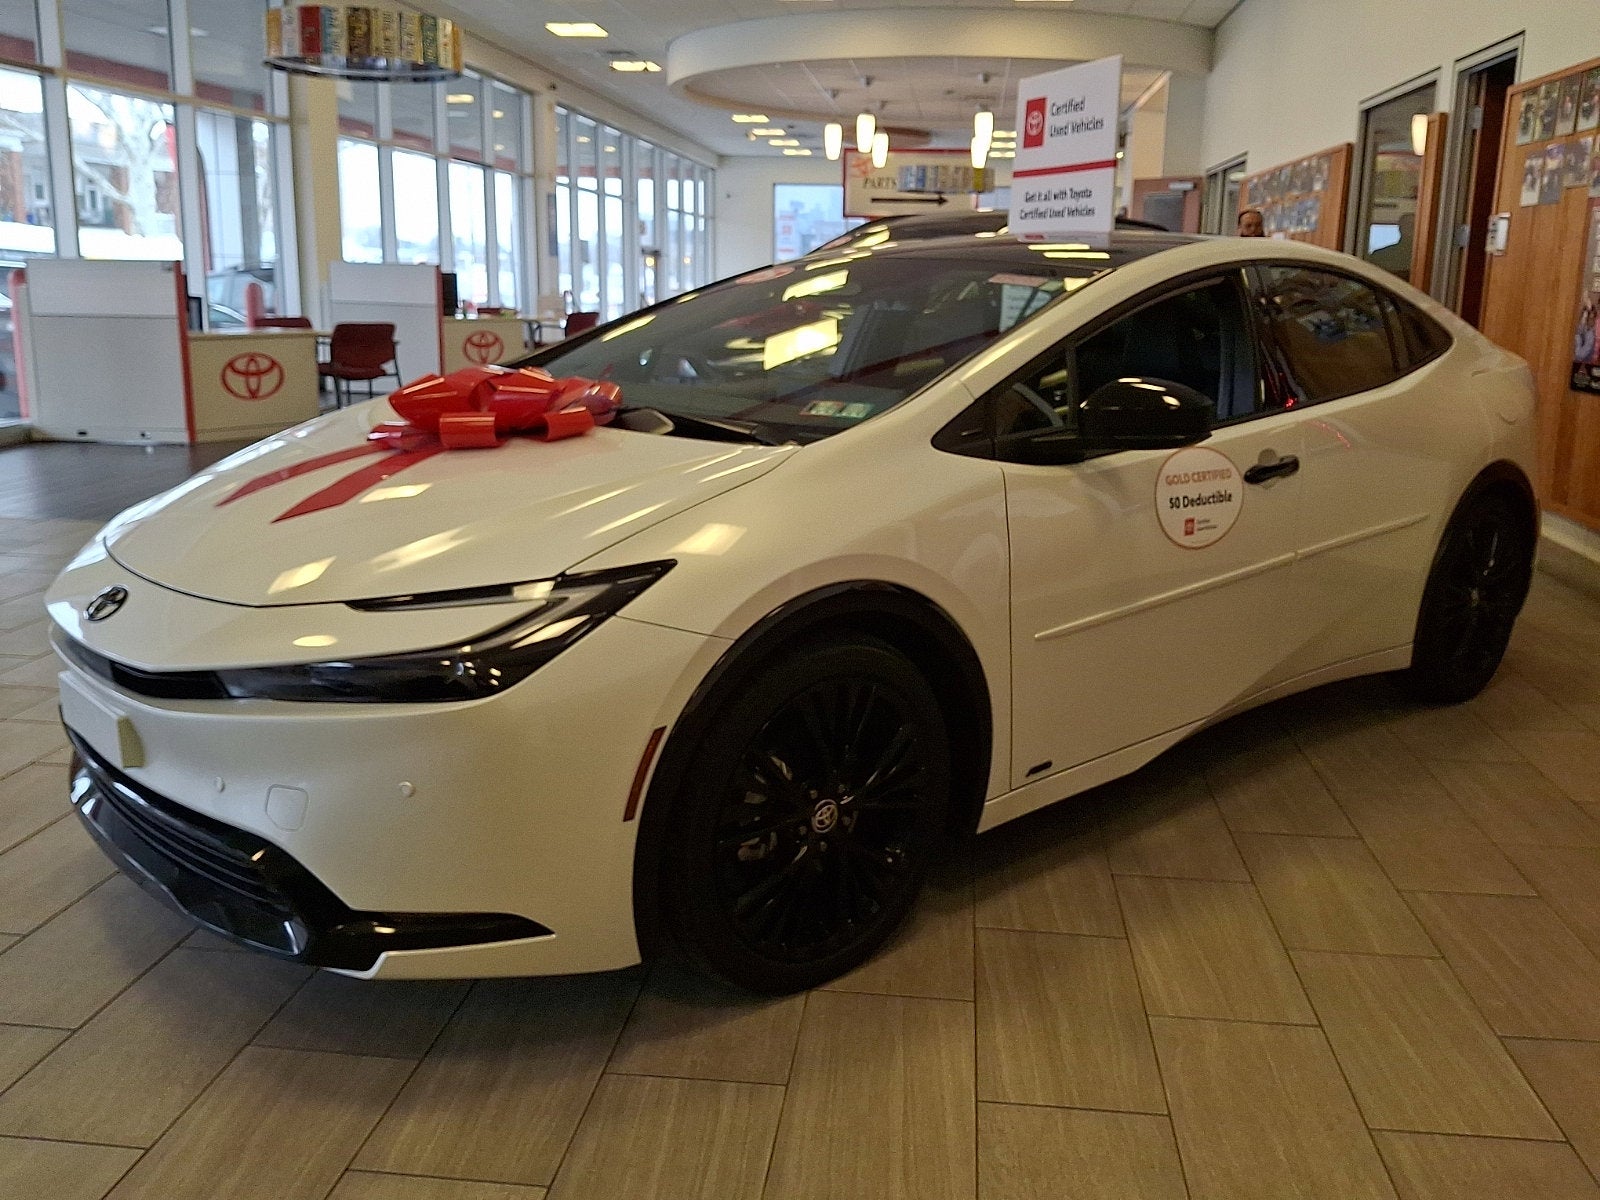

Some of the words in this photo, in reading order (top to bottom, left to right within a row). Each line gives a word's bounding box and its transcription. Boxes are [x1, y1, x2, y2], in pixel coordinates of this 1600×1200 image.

[1051, 97, 1085, 115] Certified
[1050, 123, 1069, 137] Used
[1071, 116, 1104, 134] Vehicles
[862, 176, 897, 189] PARTS
[1025, 190, 1037, 203] Get
[1043, 188, 1052, 202] all
[1053, 188, 1068, 201] with
[1069, 187, 1093, 202] Toyota
[1020, 207, 1048, 220] Certified
[1048, 206, 1065, 219] Used
[1066, 205, 1096, 218] Vehicles
[1165, 473, 1190, 486] GOLD
[1191, 468, 1232, 483] CERTIFIED
[1182, 489, 1233, 508] Deductible
